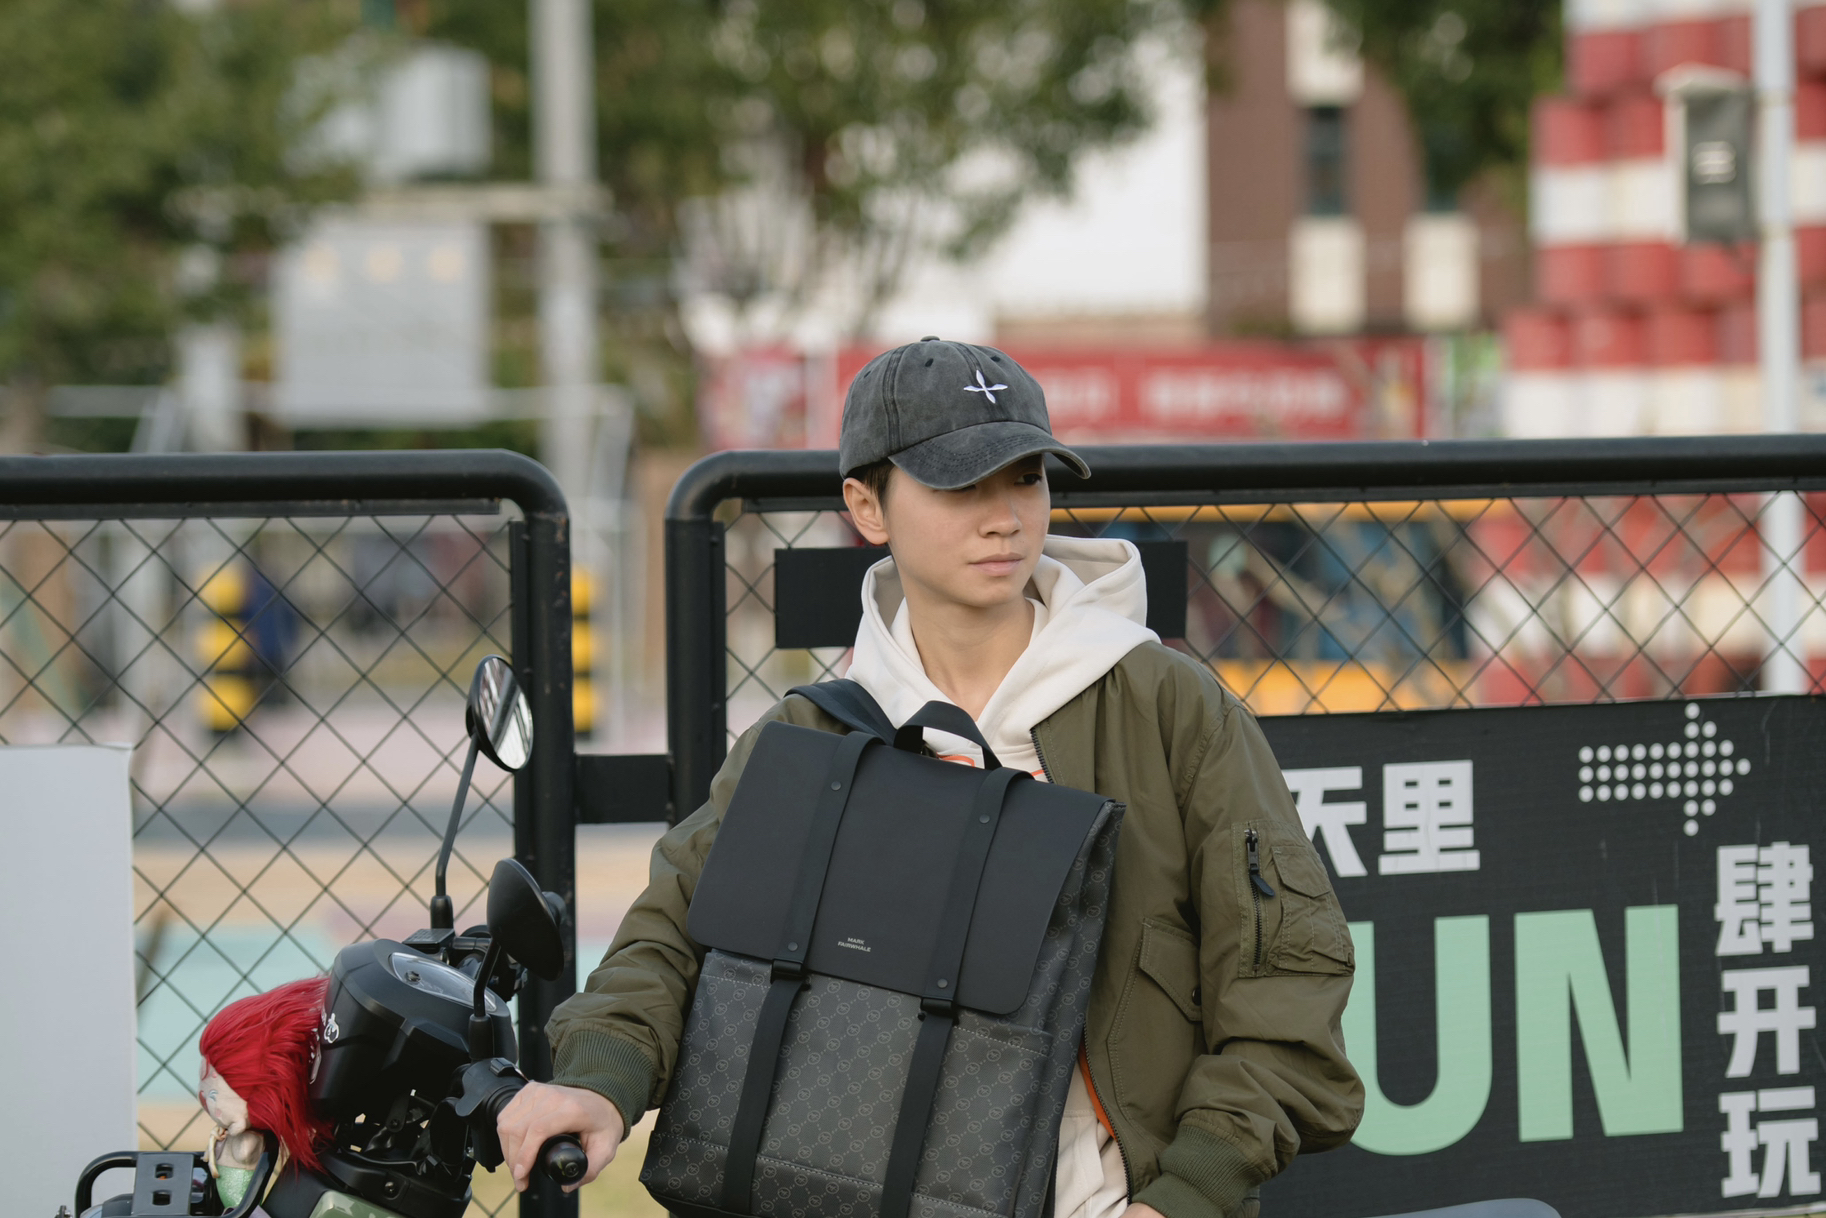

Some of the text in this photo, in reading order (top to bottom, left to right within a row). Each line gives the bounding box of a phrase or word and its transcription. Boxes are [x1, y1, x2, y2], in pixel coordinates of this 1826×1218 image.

[837, 941, 872, 952] FAIRWHALE
[847, 937, 865, 945] MARK
[1715, 841, 1822, 1200] 肆开玩
